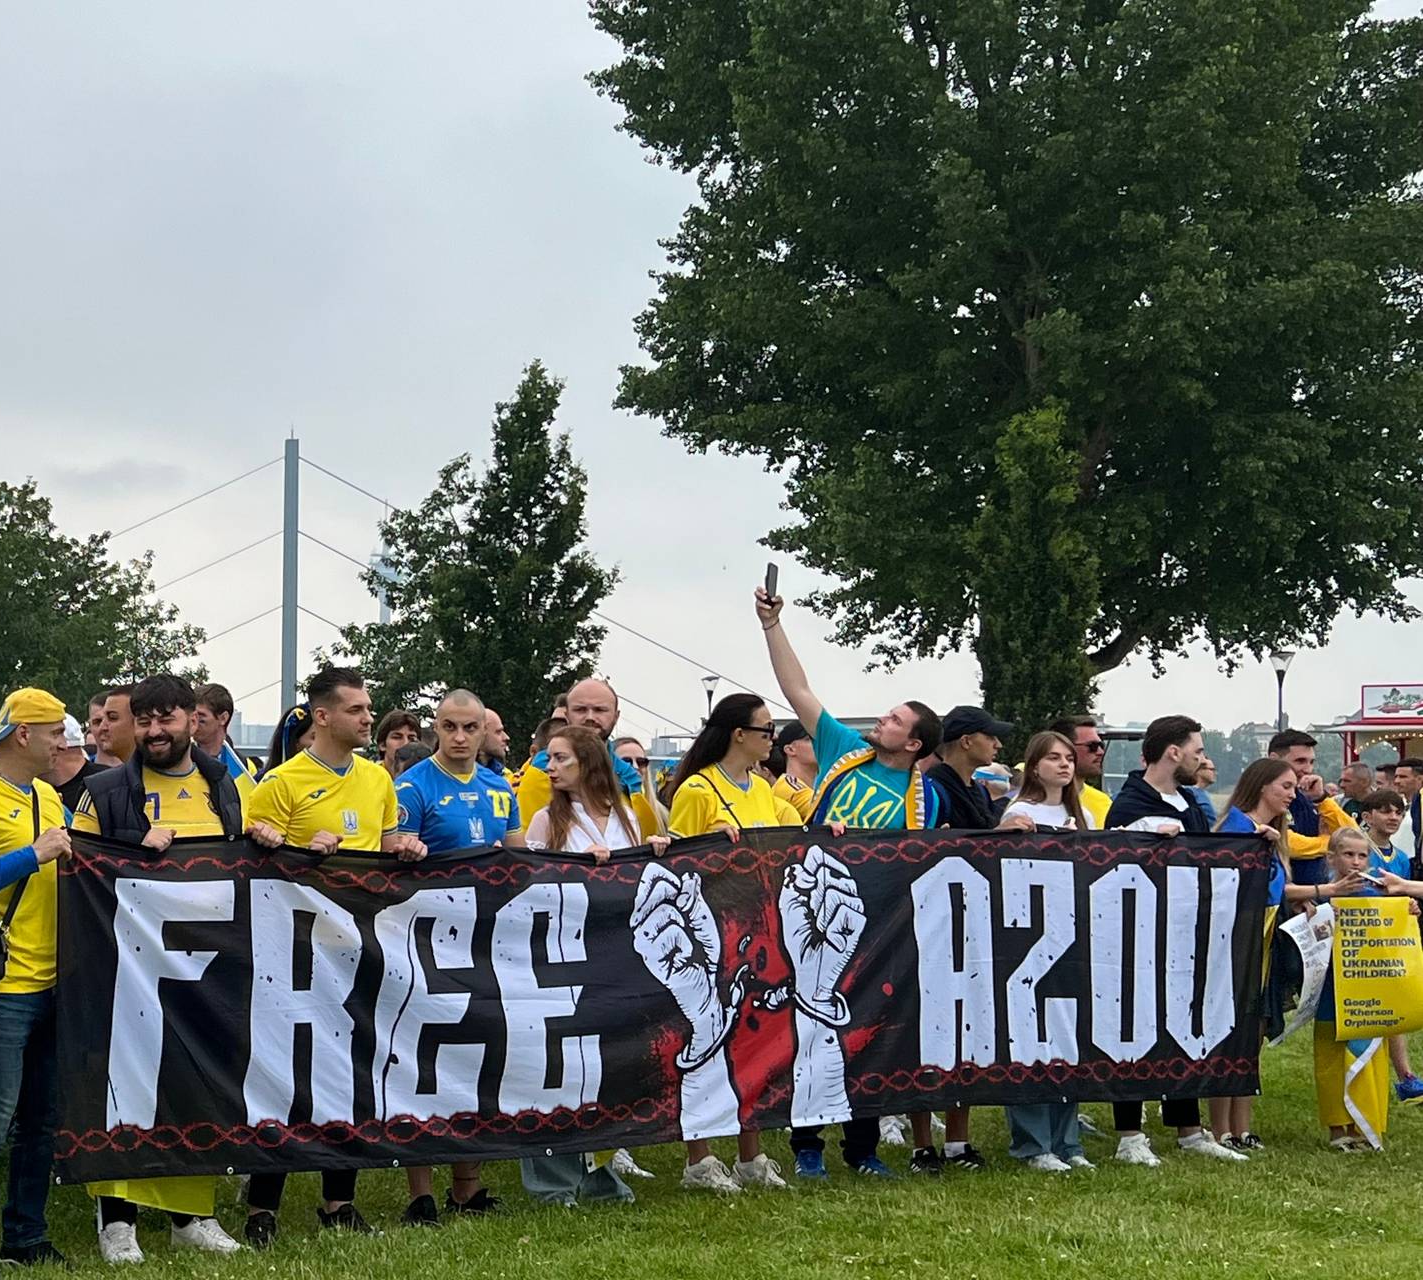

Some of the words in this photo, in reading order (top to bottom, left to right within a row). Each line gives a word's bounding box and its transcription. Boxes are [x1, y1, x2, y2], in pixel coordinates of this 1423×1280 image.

[1340, 908, 1379, 917] NEVER
[1340, 918, 1381, 927] HEARD
[1341, 928, 1366, 937] THE
[1341, 938, 1416, 947] DEPORTATION
[1342, 949, 1359, 958] OF
[1342, 959, 1404, 968] UKRAINIAN
[1343, 969, 1407, 978] CHILDREN?
[106, 877, 602, 1131] FREE
[911, 856, 1239, 1067] AZOV
[1344, 998, 1381, 1007] Google
